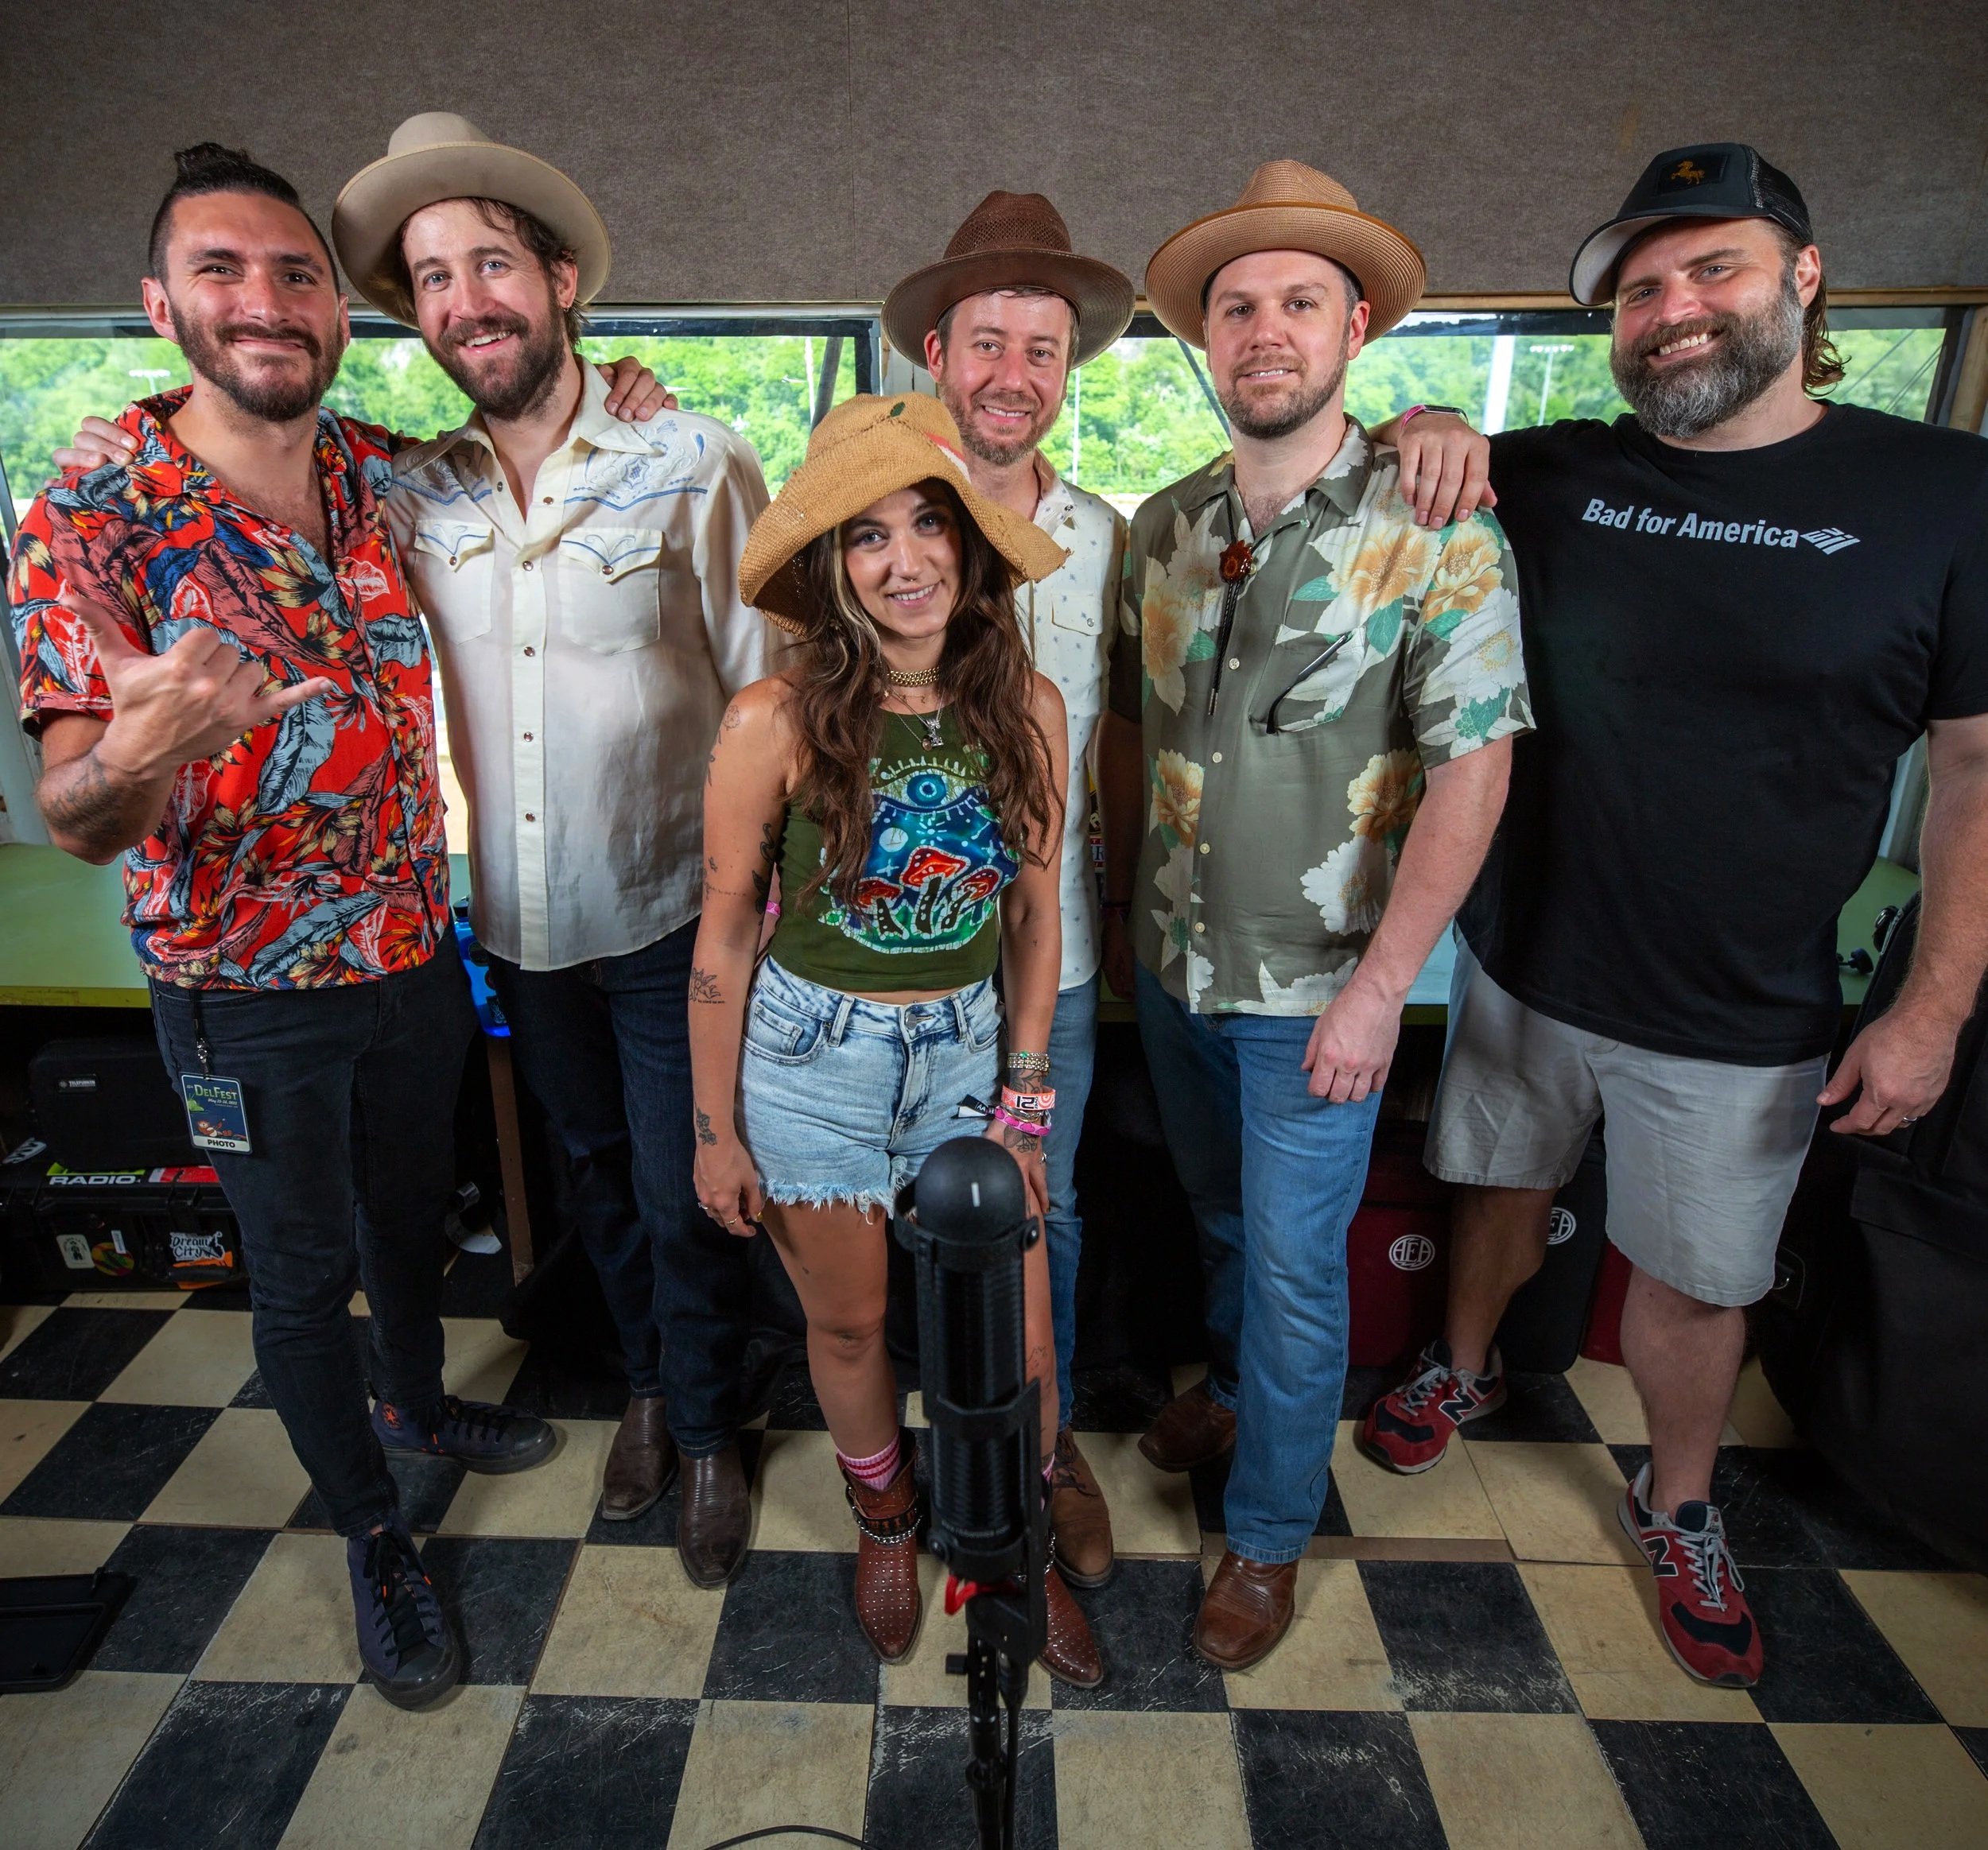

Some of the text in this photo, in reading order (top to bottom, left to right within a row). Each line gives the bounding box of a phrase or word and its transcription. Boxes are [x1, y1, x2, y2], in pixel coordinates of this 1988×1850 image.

[1582, 498, 1800, 549] Bad for America
[207, 1138, 235, 1148] PHOTO
[49, 1175, 136, 1185] RADIO
[1547, 1212, 1573, 1236] EA
[173, 1236, 208, 1247] Dream
[174, 1246, 202, 1258] City
[1392, 1238, 1432, 1264] AEA
